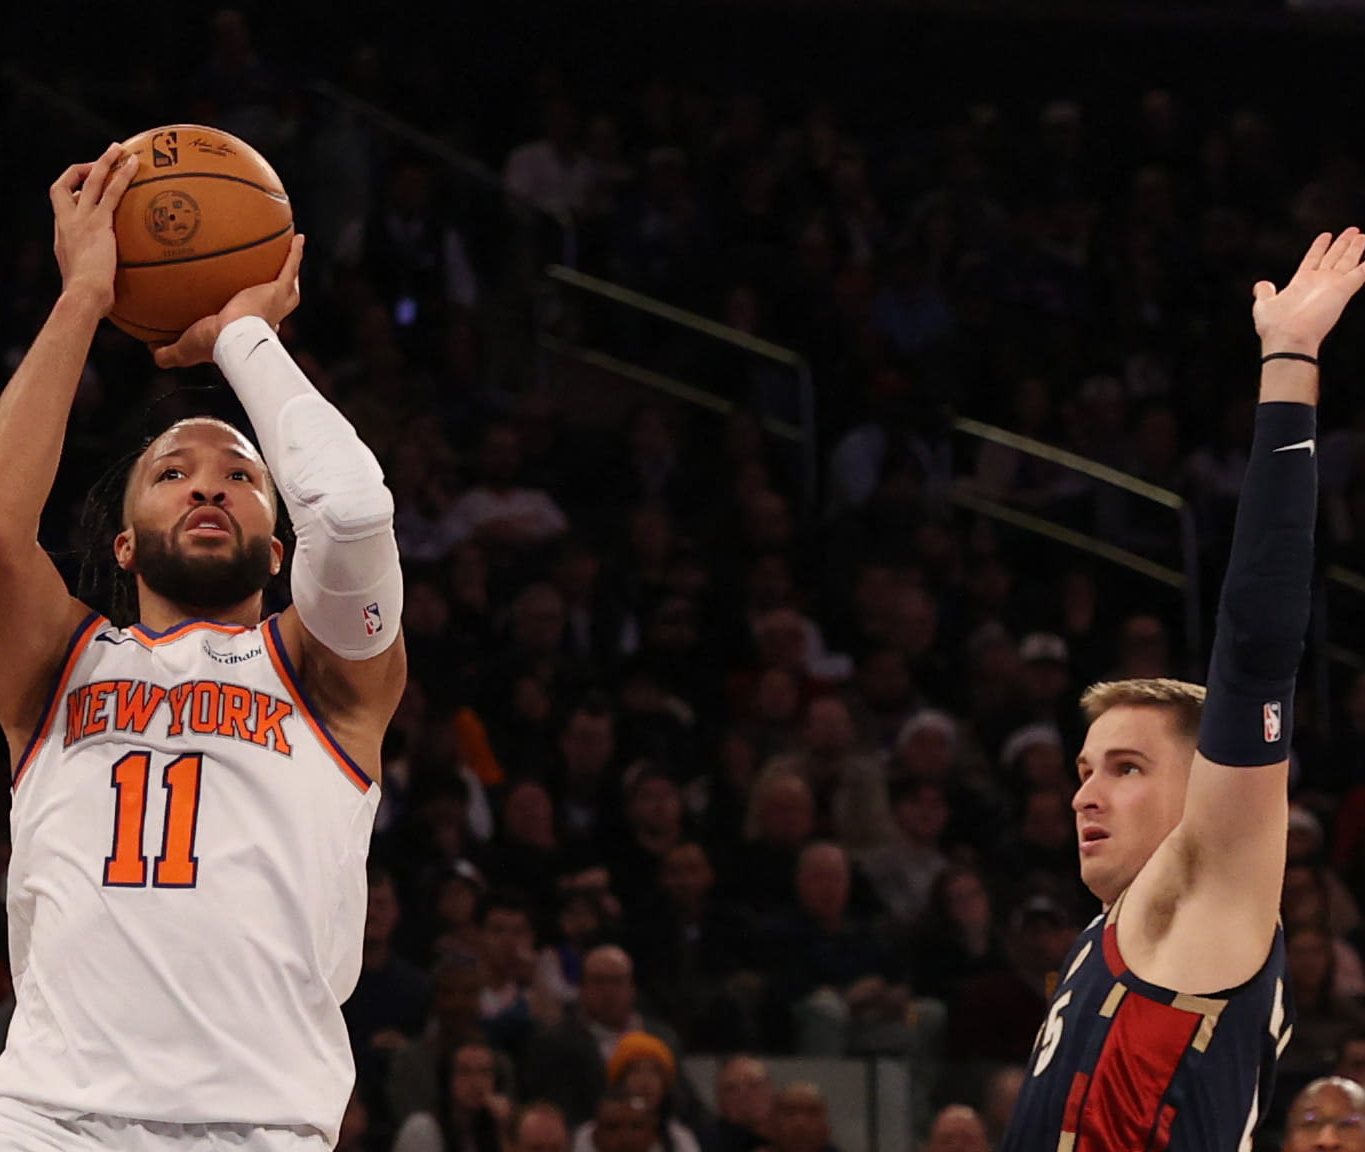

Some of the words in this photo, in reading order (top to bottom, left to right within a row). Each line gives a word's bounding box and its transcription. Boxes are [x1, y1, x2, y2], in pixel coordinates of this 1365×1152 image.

[62, 679, 167, 750] NEW
[166, 679, 294, 758] YORK
[102, 750, 204, 889] 11
[1033, 988, 1074, 1078] 5
